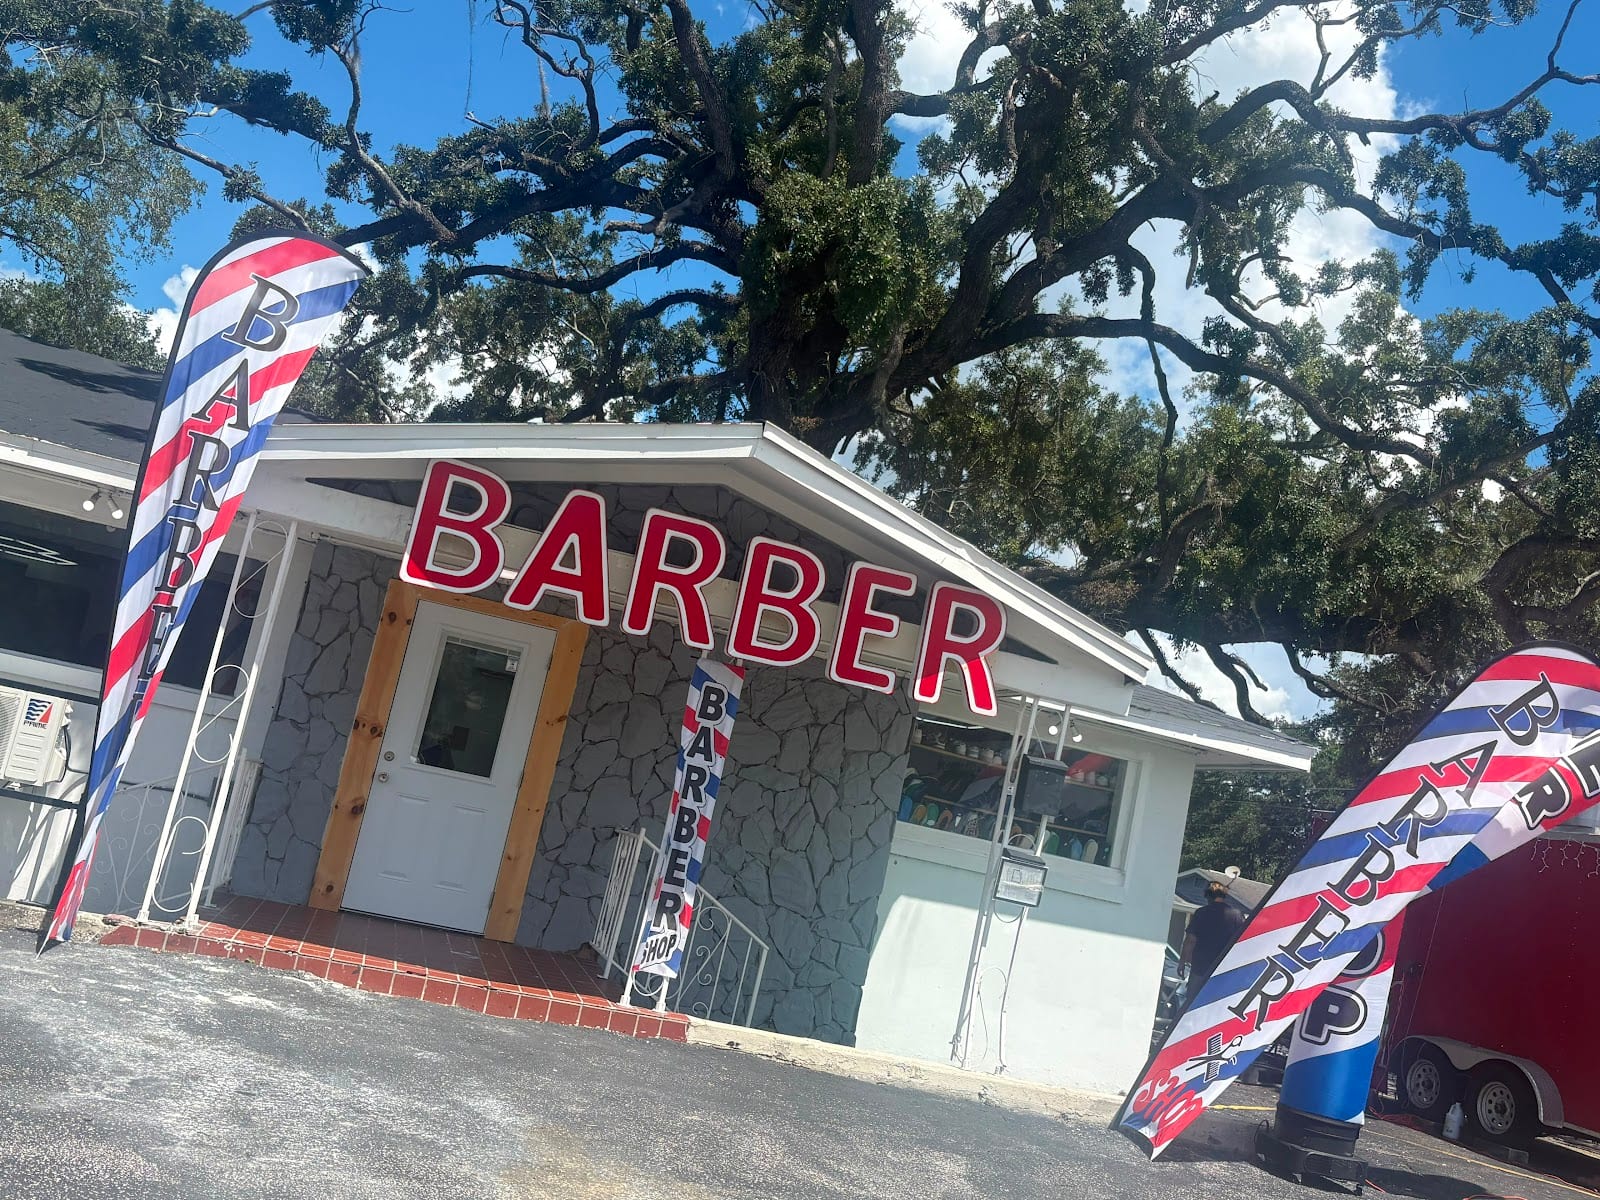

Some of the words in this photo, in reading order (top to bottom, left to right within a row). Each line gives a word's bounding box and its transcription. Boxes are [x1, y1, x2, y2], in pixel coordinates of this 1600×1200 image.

[399, 459, 1008, 717] BARBER
[650, 683, 727, 931] BARBER
[1228, 671, 1560, 1030] BARBER
